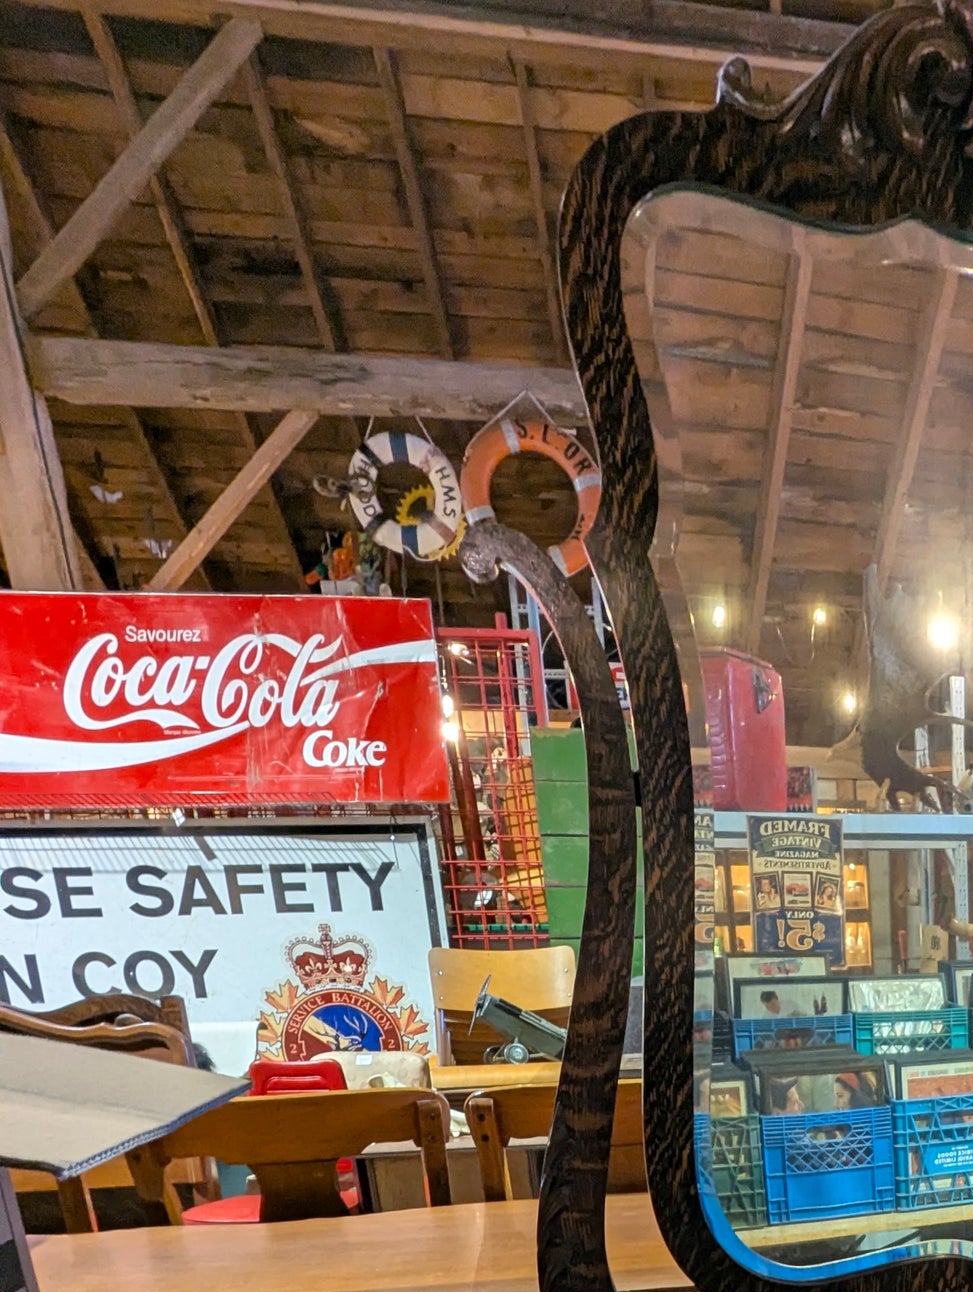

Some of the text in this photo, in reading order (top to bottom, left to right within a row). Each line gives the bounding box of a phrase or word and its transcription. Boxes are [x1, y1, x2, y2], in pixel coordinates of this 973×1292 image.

[435, 465, 457, 518] HMS
[124, 624, 202, 643] Savourez
[63, 632, 344, 731] Coca-Cola
[302, 729, 388, 768] Coke
[0, 861, 395, 920] SE SAFETY
[72, 949, 218, 1000] COY
[288, 993, 393, 1035] SERVICE BATTALION
[289, 1043, 297, 1054] 2
[387, 1039, 396, 1049] 2
